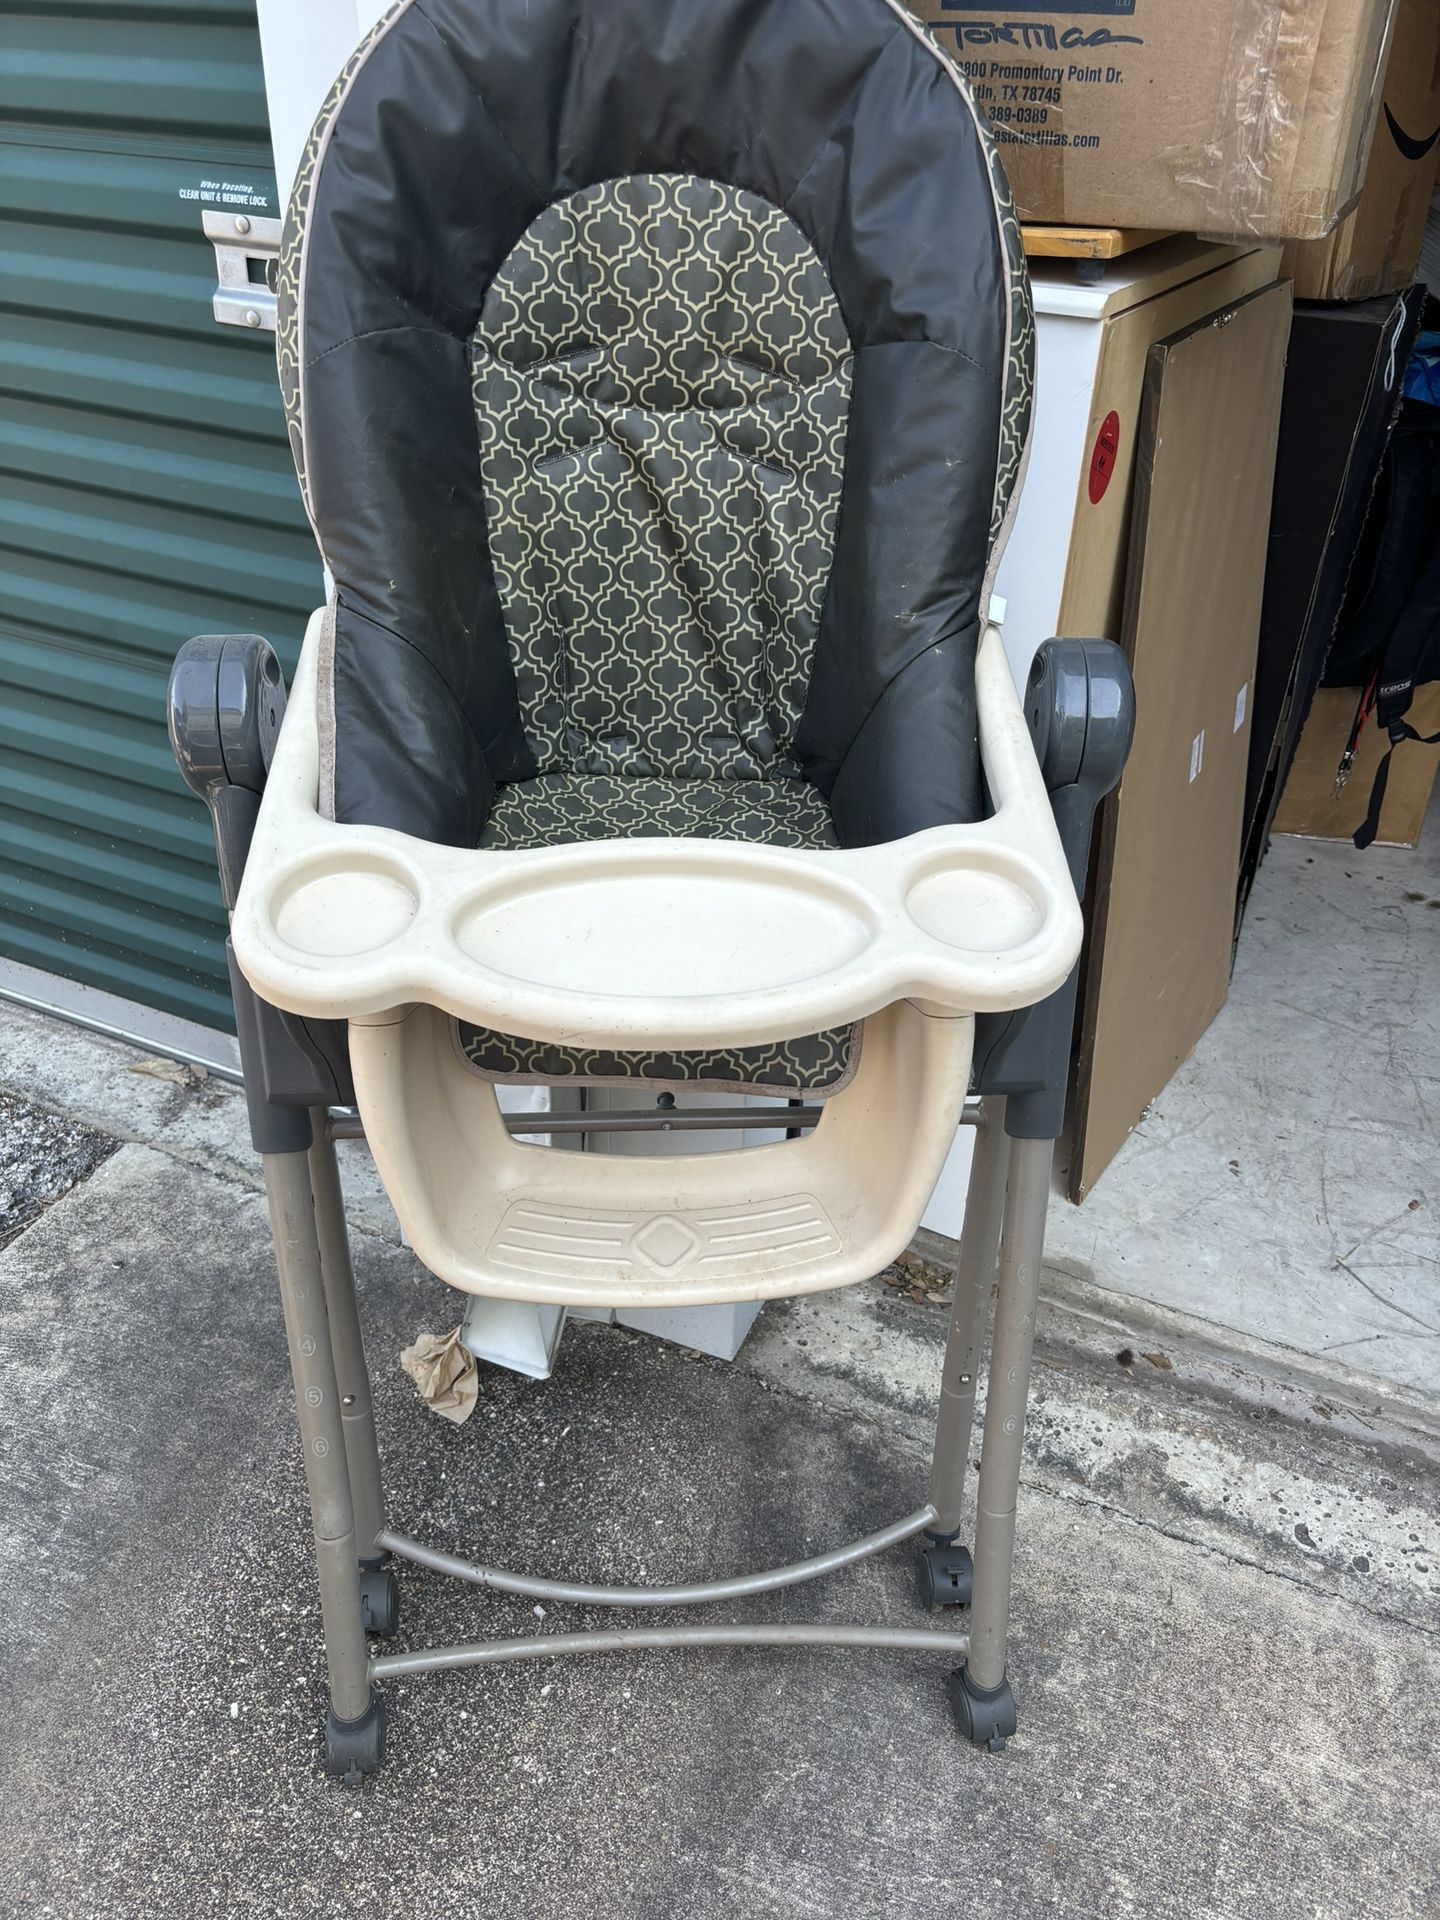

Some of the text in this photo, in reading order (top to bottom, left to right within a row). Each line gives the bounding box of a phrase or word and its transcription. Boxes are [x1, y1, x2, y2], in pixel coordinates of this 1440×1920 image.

[990, 63, 1065, 84] Promontory
[1067, 65, 1102, 83] Point
[1105, 67, 1124, 84] Dr.
[1002, 85, 1018, 101] TX
[1022, 86, 1061, 103] 78745
[989, 106, 1048, 123] 389-0389
[200, 180, 220, 190] When
[179, 188, 200, 200] CLEAN
[200, 190, 216, 202] UNIT
[216, 194, 221, 202] &
[222, 193, 249, 205] REMOVE
